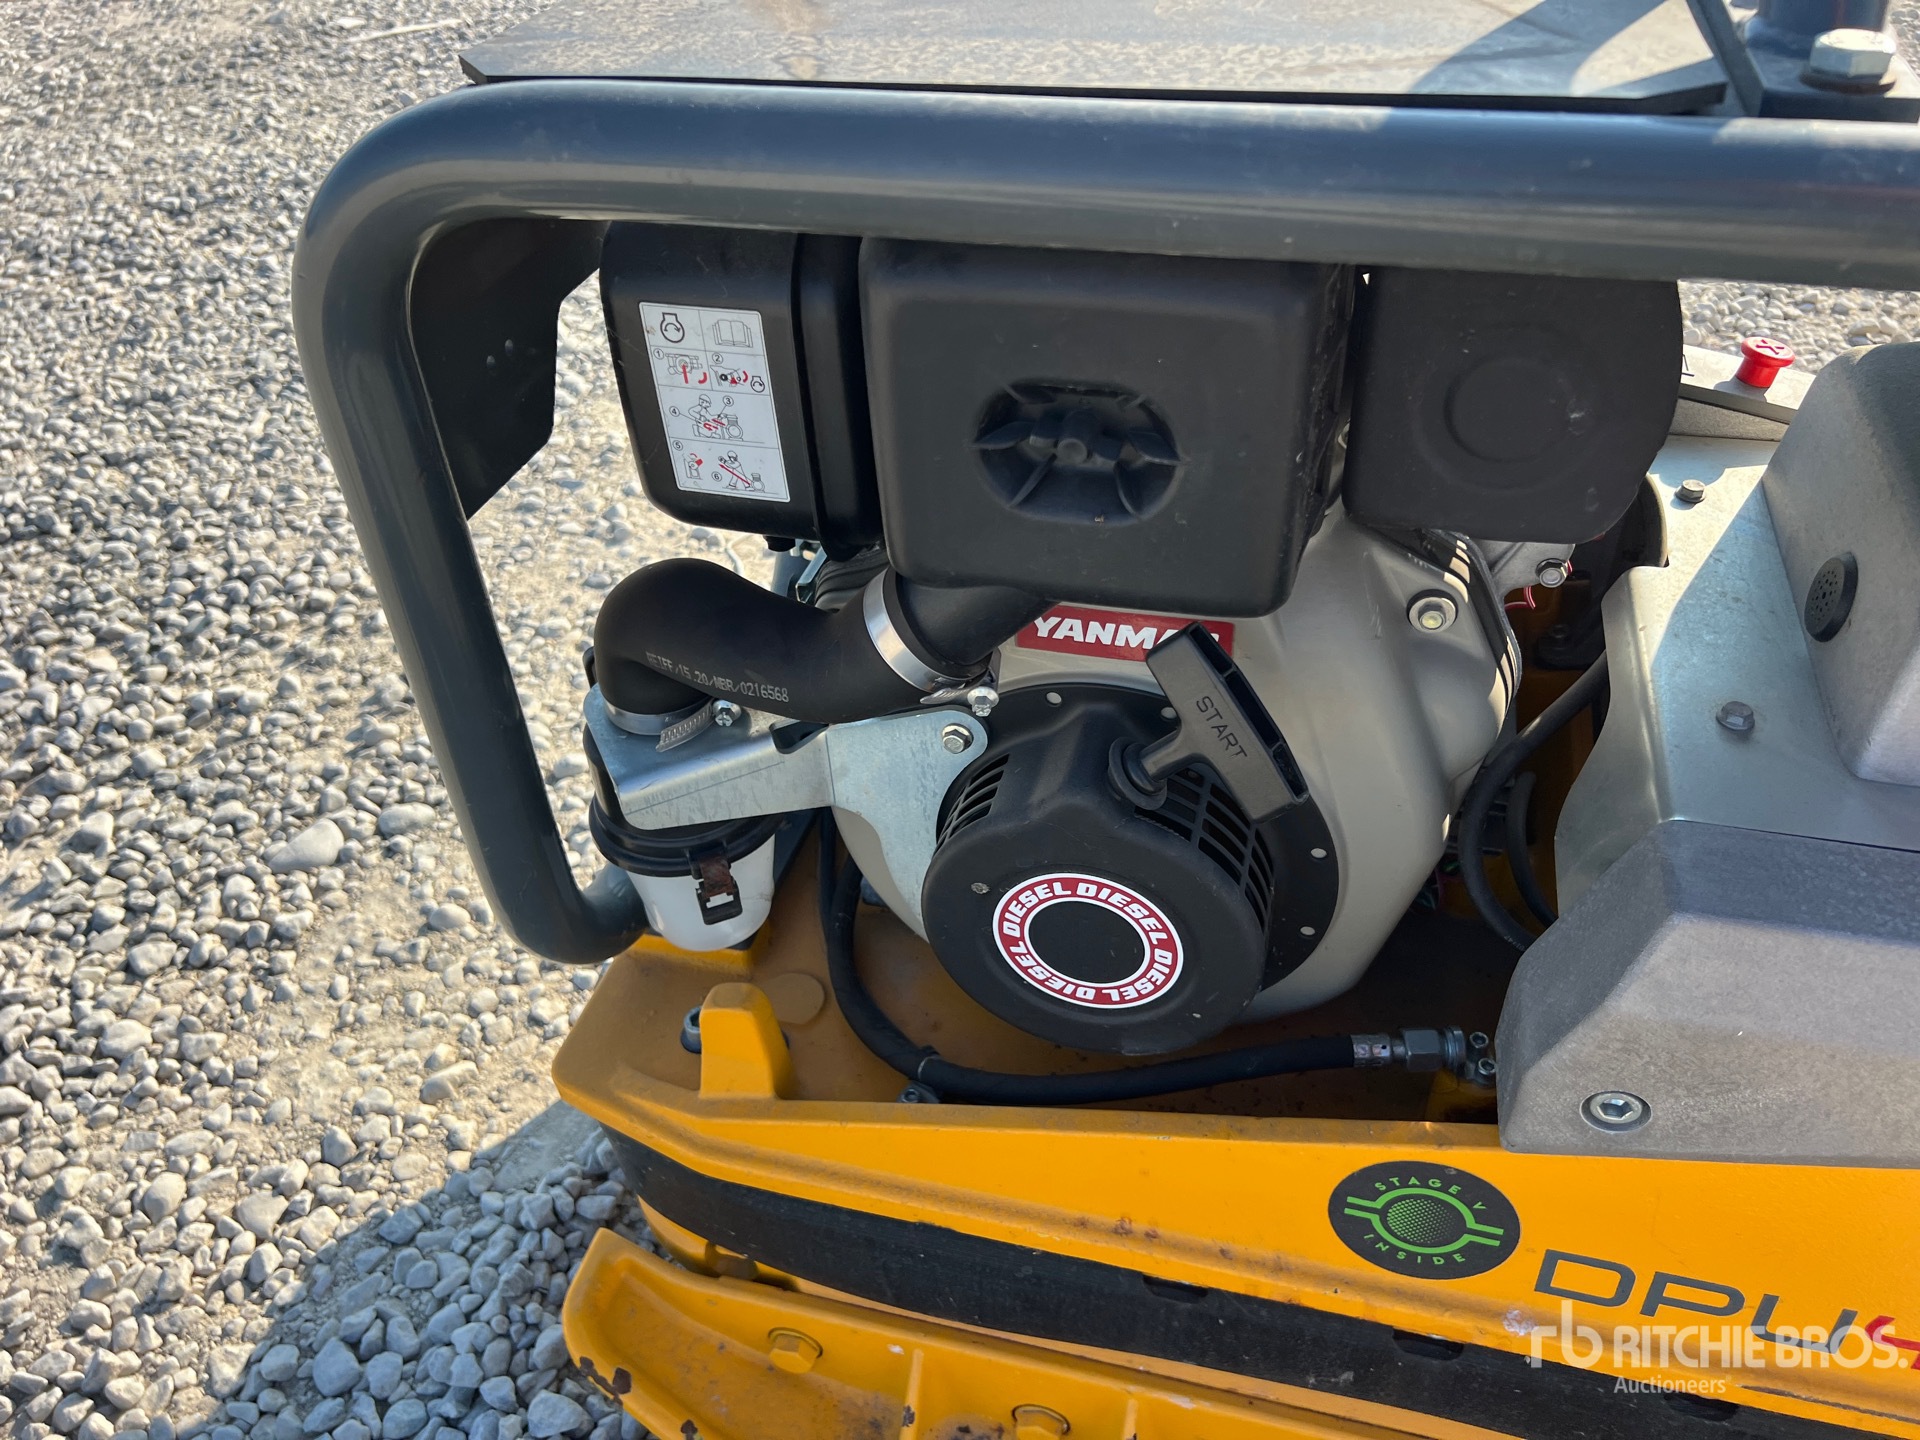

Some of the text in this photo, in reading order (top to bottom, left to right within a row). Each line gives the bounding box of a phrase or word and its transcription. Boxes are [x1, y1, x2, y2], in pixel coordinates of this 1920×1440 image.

[1034, 615, 1220, 650] YANM
[1196, 695, 1248, 759] START
[1003, 882, 1072, 938] DIESEL
[1076, 882, 1168, 945] DIESEL
[1010, 941, 1096, 1001] DIESEL
[1102, 948, 1173, 1002] DIESEL
[1374, 1176, 1487, 1212] STAGE V
[1363, 1233, 1466, 1265] INSIDE
